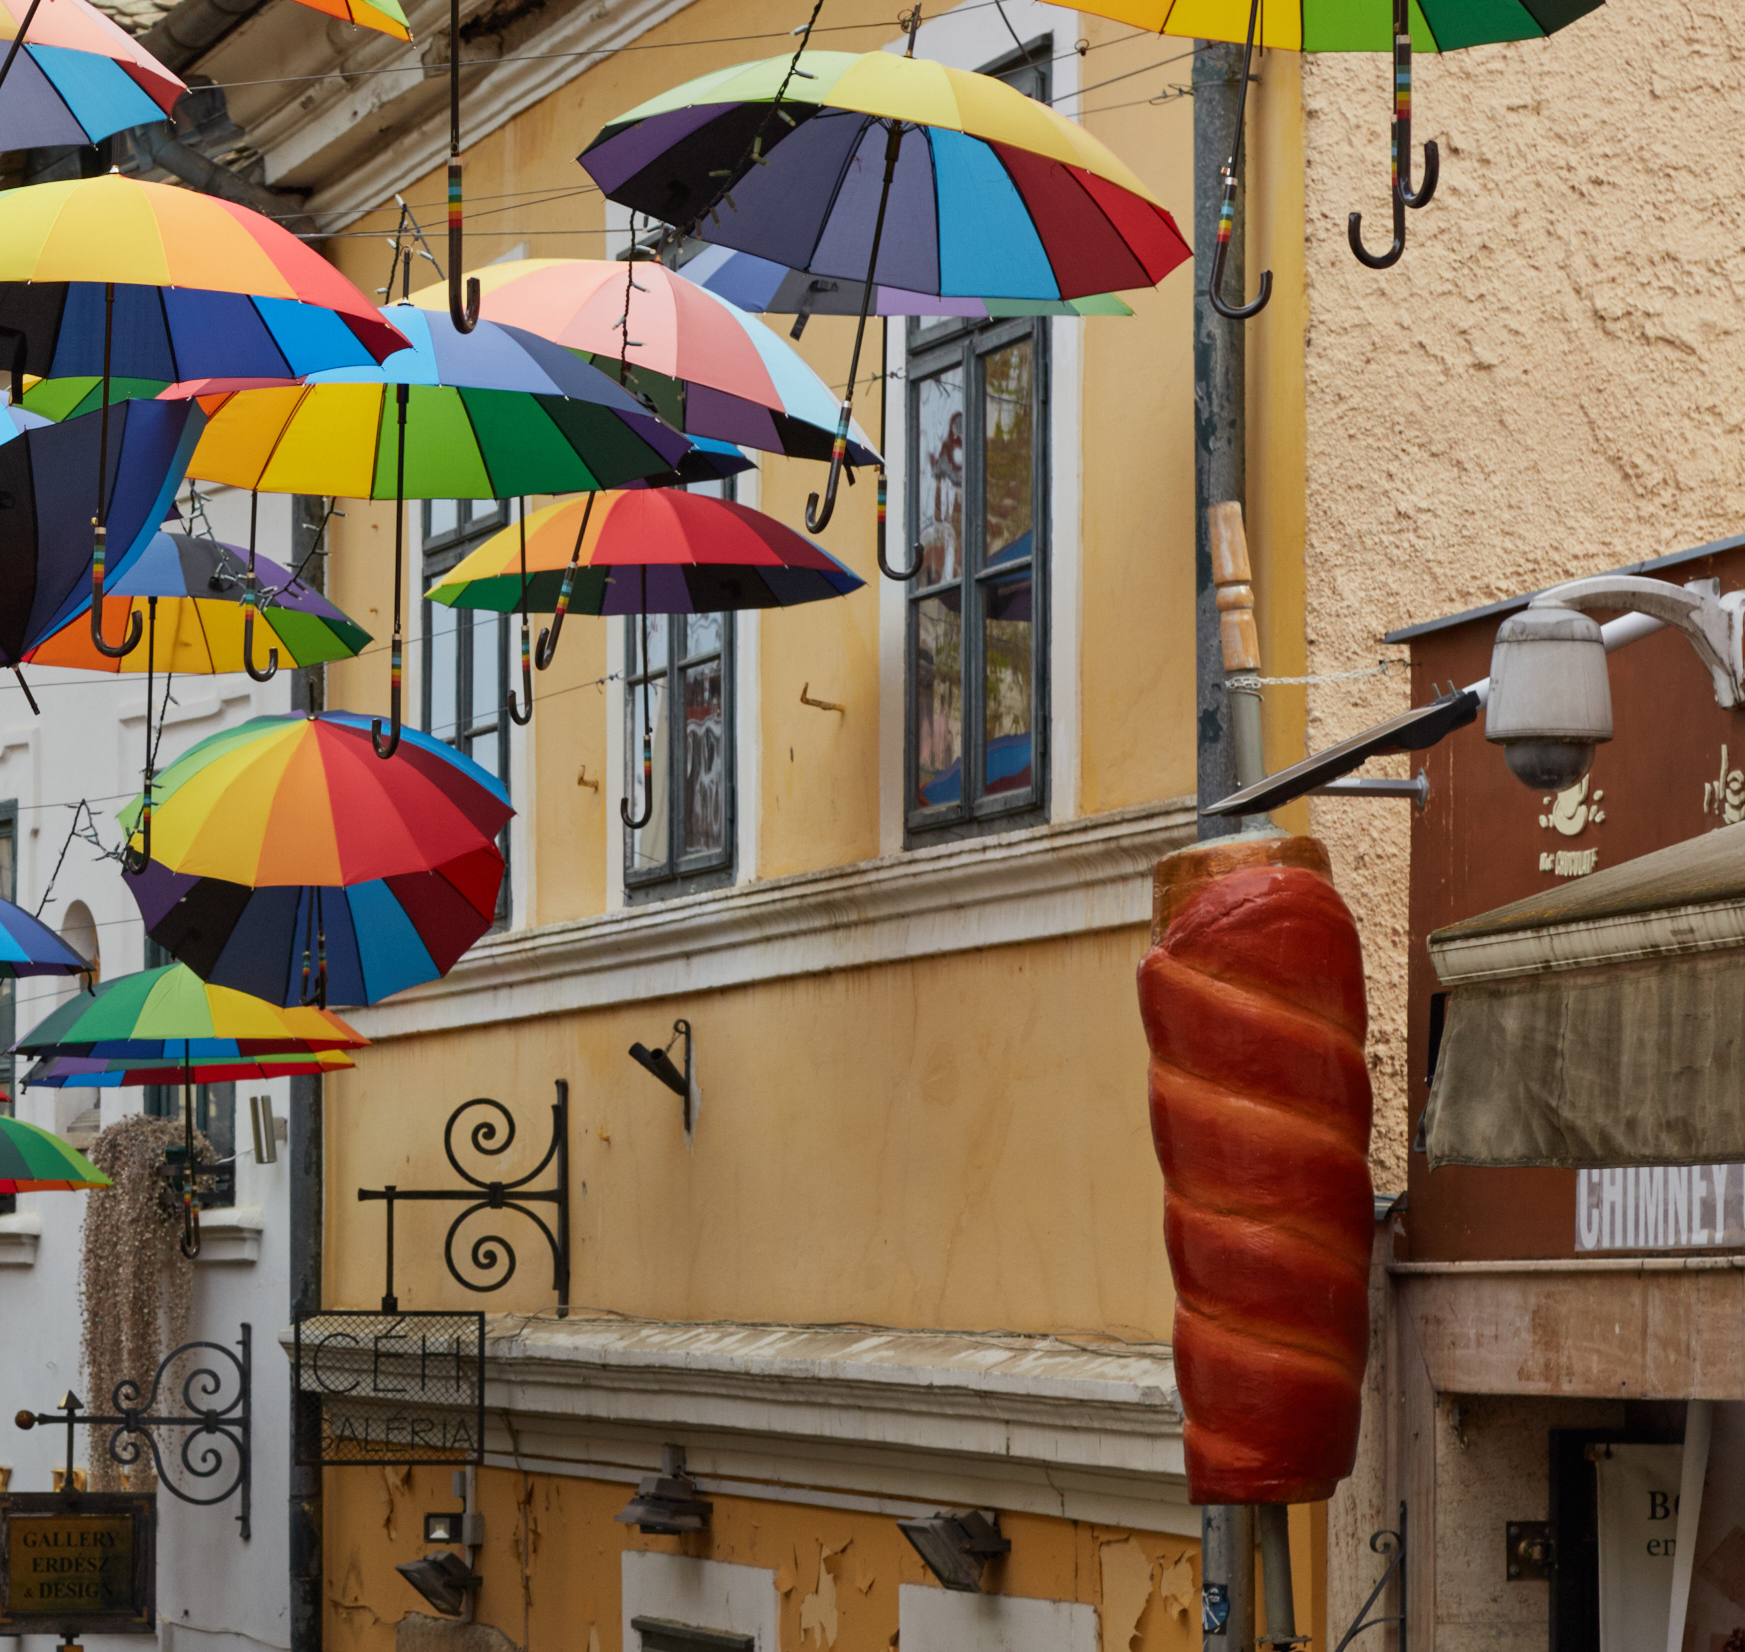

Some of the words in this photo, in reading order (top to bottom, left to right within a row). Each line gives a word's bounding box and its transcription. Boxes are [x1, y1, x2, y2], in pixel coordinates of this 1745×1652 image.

[1579, 1164, 1728, 1249] CHIMNEY
[314, 1316, 461, 1394] CÉH
[22, 1531, 118, 1548] GALLERY
[31, 1552, 110, 1573] ERDÉSZ
[23, 1587, 34, 1598] &
[39, 1581, 114, 1598] DESIGN
